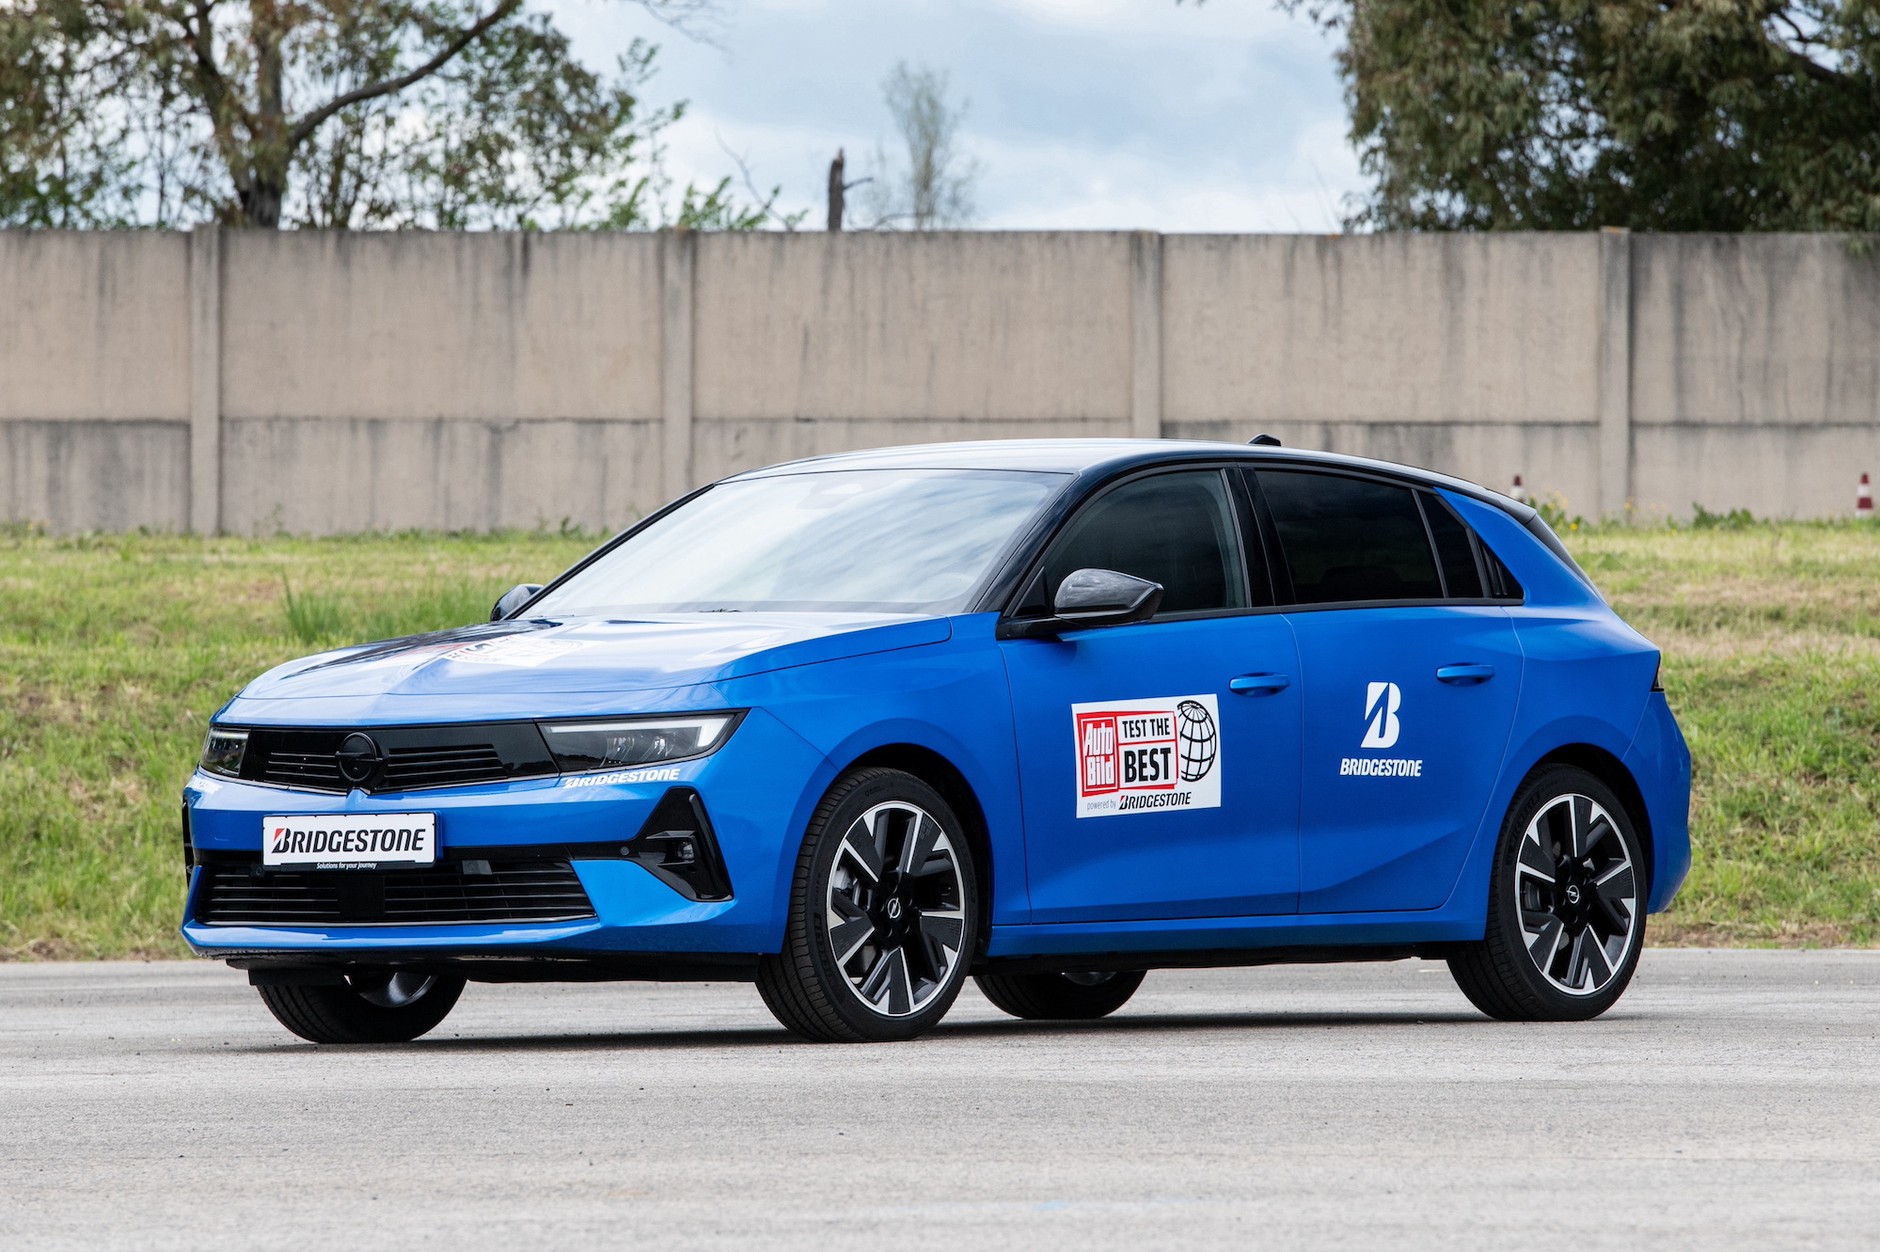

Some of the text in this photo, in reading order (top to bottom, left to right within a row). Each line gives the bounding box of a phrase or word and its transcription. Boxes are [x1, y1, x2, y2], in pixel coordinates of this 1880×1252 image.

[1122, 718, 1170, 738] TEST THE
[1084, 722, 1113, 756] Auto
[1086, 755, 1115, 786] Bild
[1124, 747, 1171, 783] BEST
[1340, 758, 1422, 777] BRIDGESTONE
[563, 768, 680, 789] BRIDGESTONE
[1087, 791, 1192, 812] powered by BRIDGESTONE
[271, 827, 426, 854] BRIDGESTONE
[357, 862, 377, 870] journey
